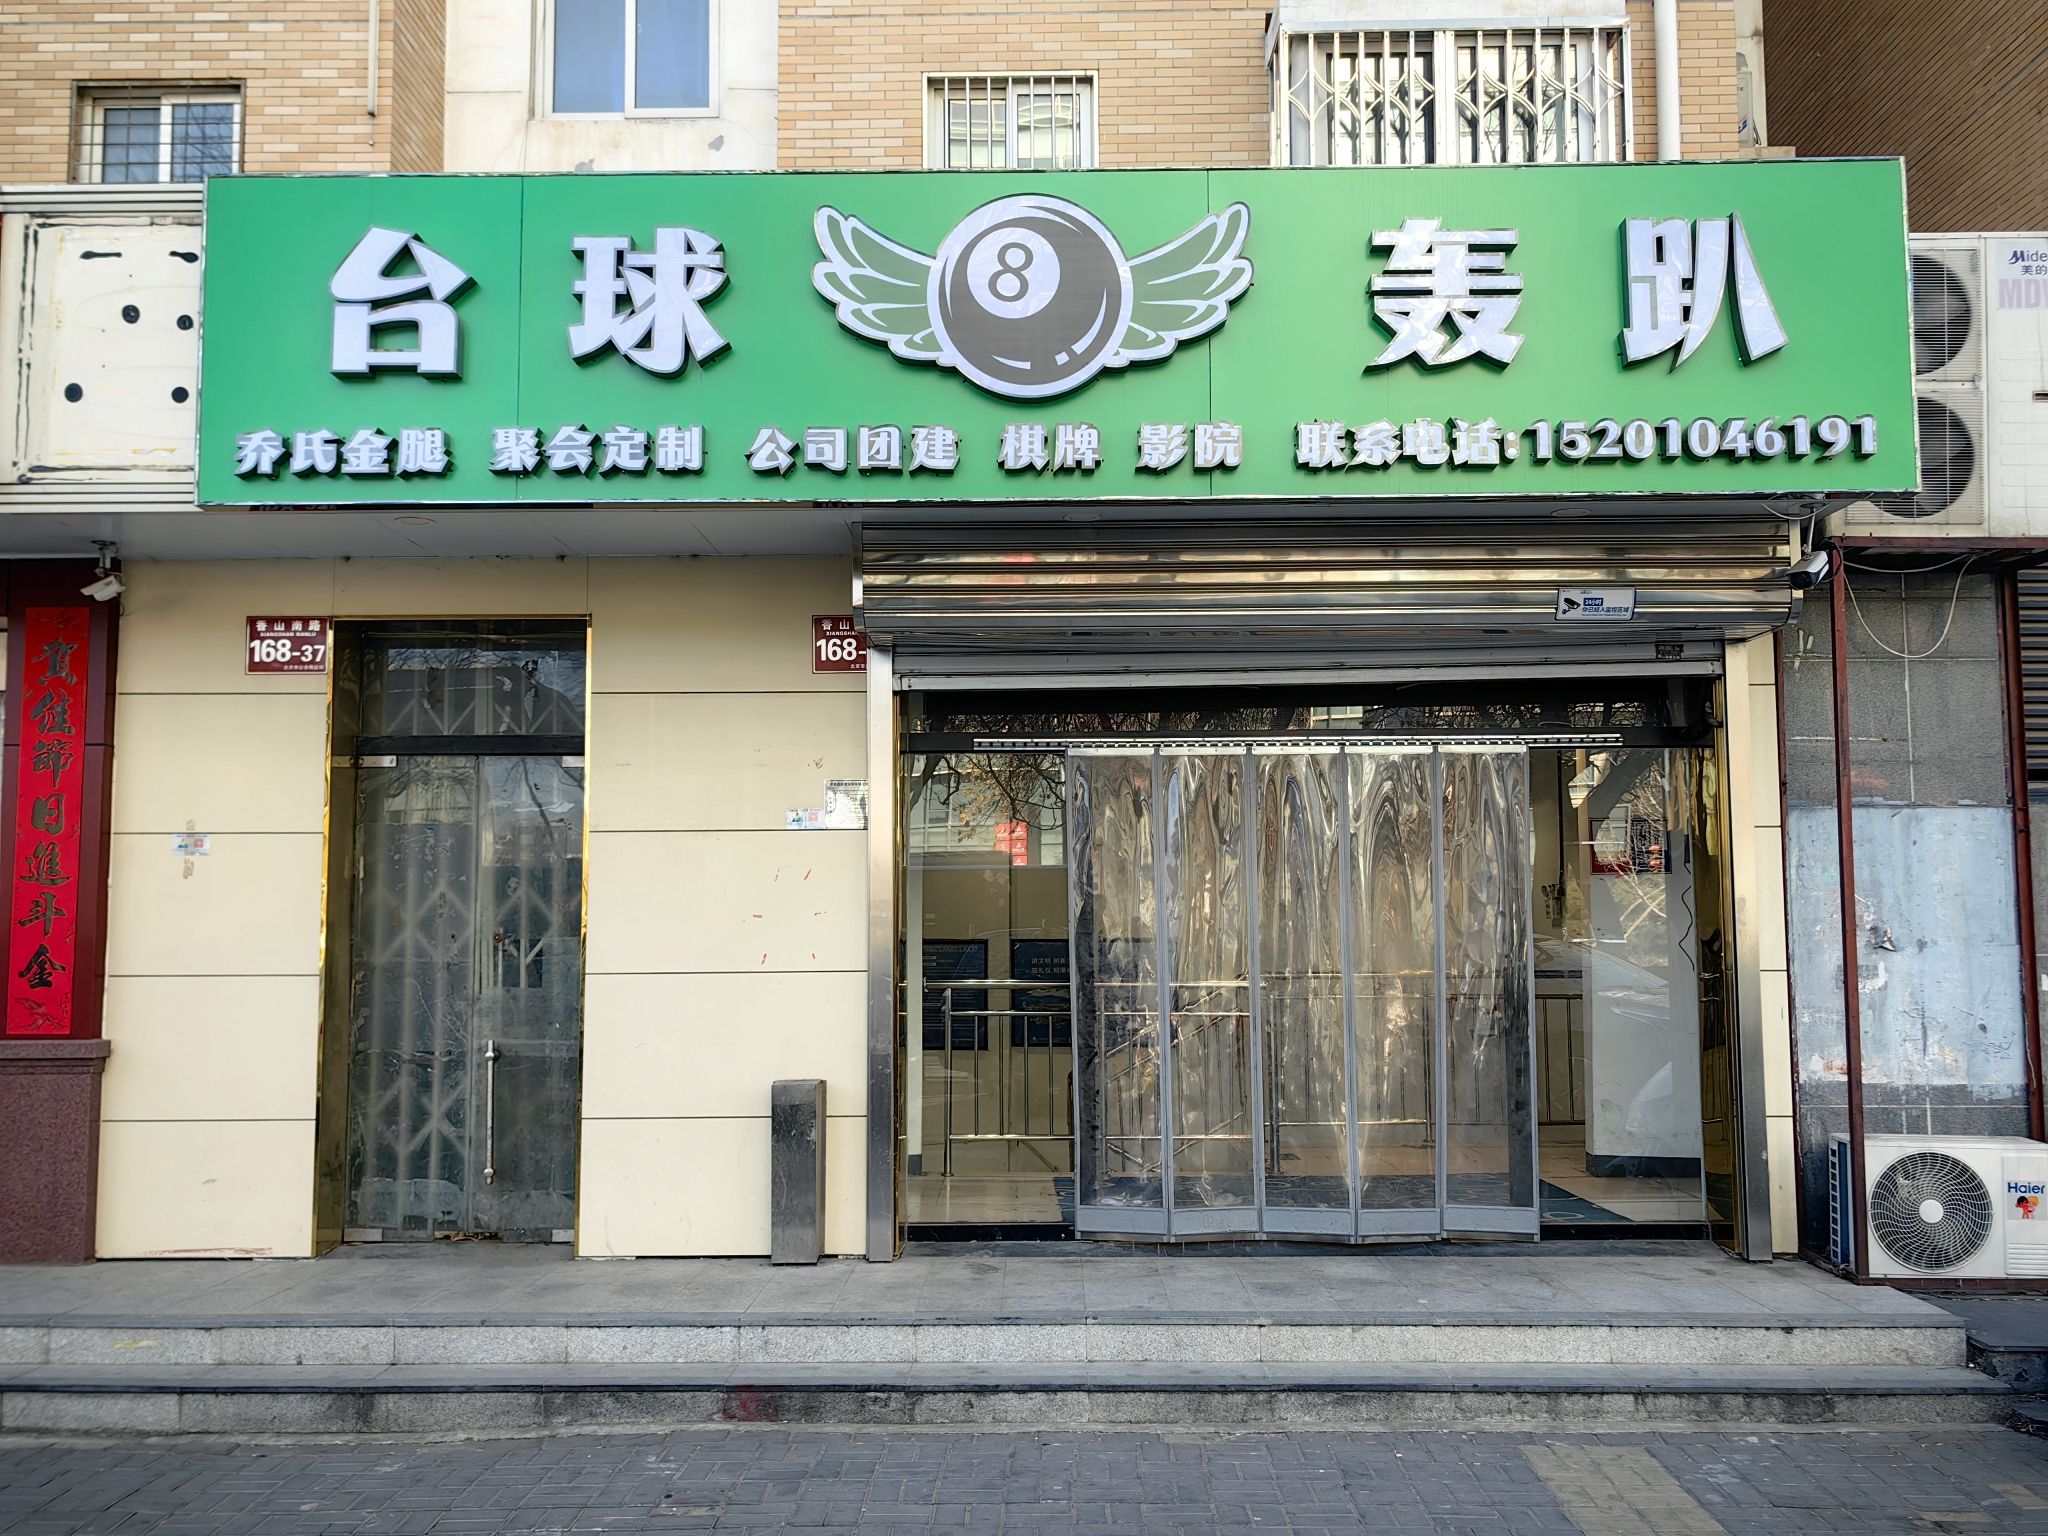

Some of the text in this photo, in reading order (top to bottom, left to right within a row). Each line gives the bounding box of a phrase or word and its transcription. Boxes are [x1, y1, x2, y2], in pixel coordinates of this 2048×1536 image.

[987, 241, 1034, 303] 8
[2020, 265, 2048, 275] 美的
[328, 212, 1790, 378] 台球 轰趴
[236, 427, 455, 477] 乔氏金腿
[489, 424, 705, 476] 聚会定制
[745, 423, 961, 477] 公司团建
[998, 421, 1102, 476] 棋牌
[1136, 420, 1243, 474] 影院
[255, 619, 321, 632] 香山南路
[249, 638, 326, 662] 168-37
[816, 638, 867, 661] 168-
[2007, 1182, 2045, 1194] Haier
